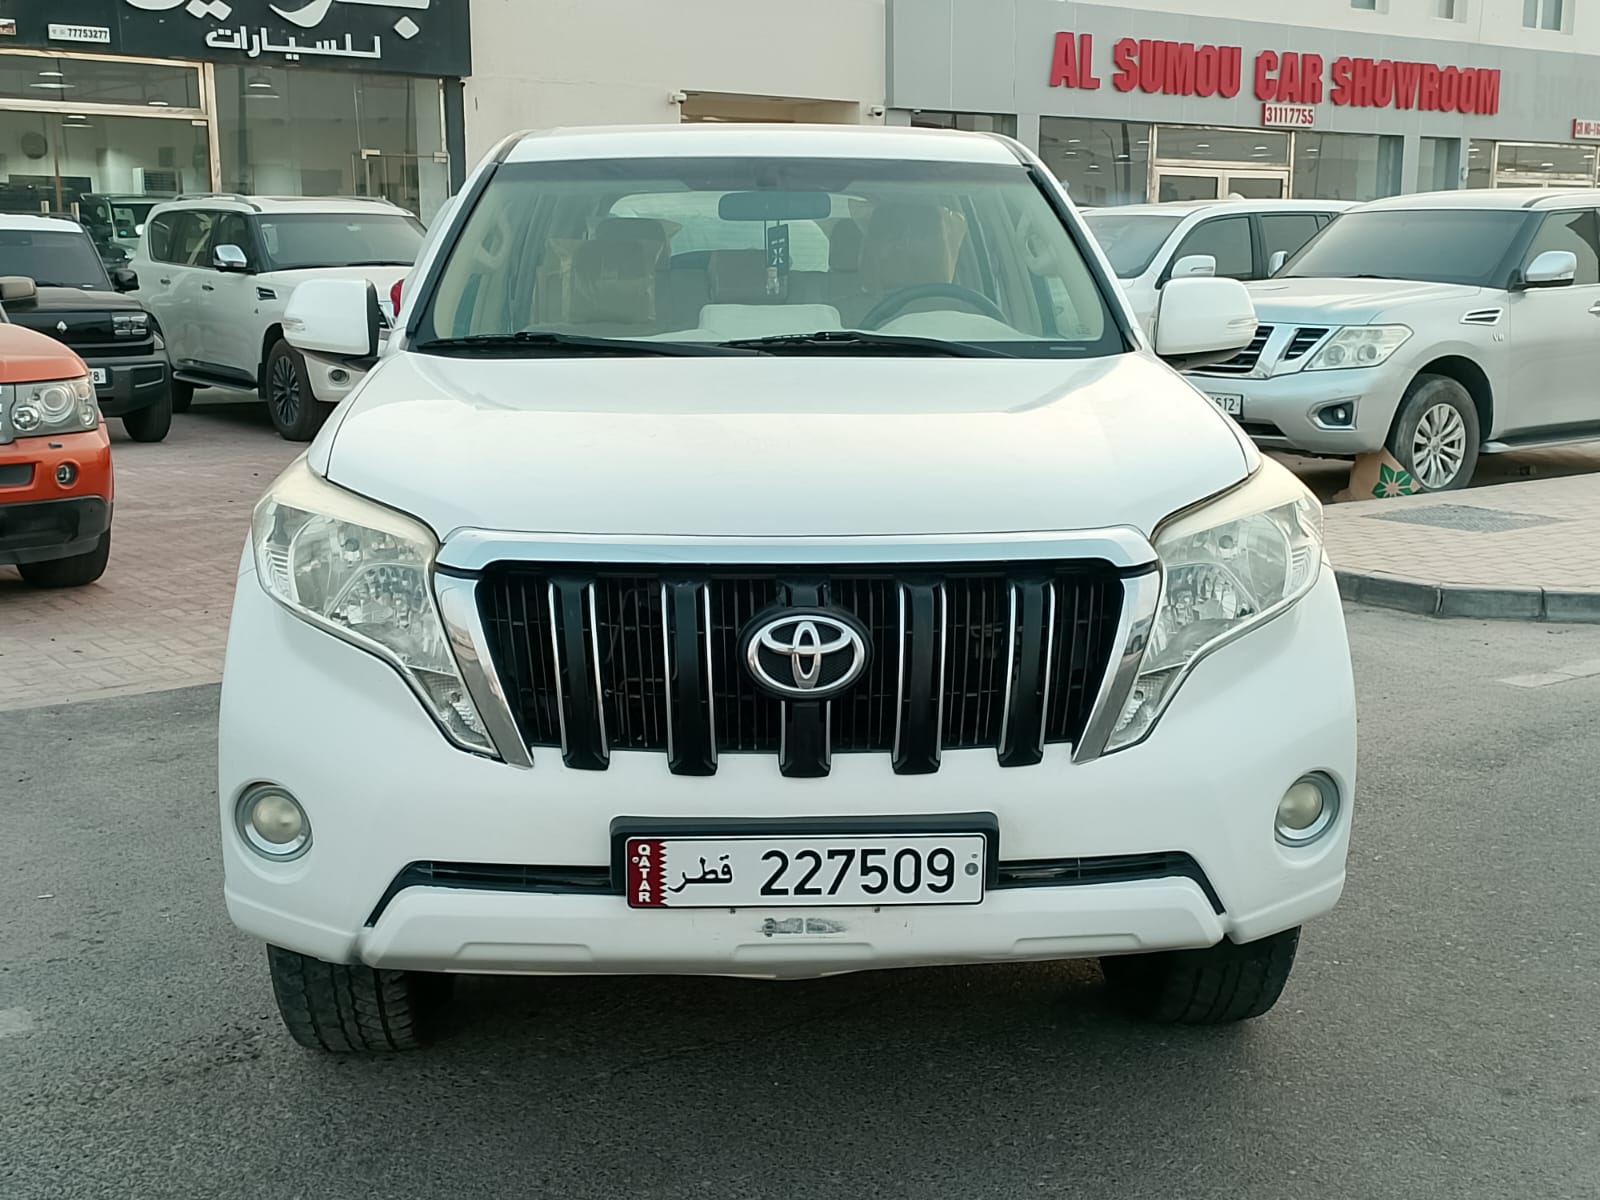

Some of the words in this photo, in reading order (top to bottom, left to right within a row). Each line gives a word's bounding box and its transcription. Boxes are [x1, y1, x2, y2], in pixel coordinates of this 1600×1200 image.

[67, 28, 108, 40] 77753277
[1049, 32, 1101, 89] AL
[1112, 37, 1242, 98] SUMOU
[1254, 50, 1323, 104] CAR
[1330, 57, 1501, 115] SHOWROOM
[1266, 106, 1314, 124] 31117755
[1211, 396, 1235, 411] 512
[638, 844, 651, 903] QATAR
[667, 854, 733, 894] قطر
[759, 847, 956, 897] 227509
